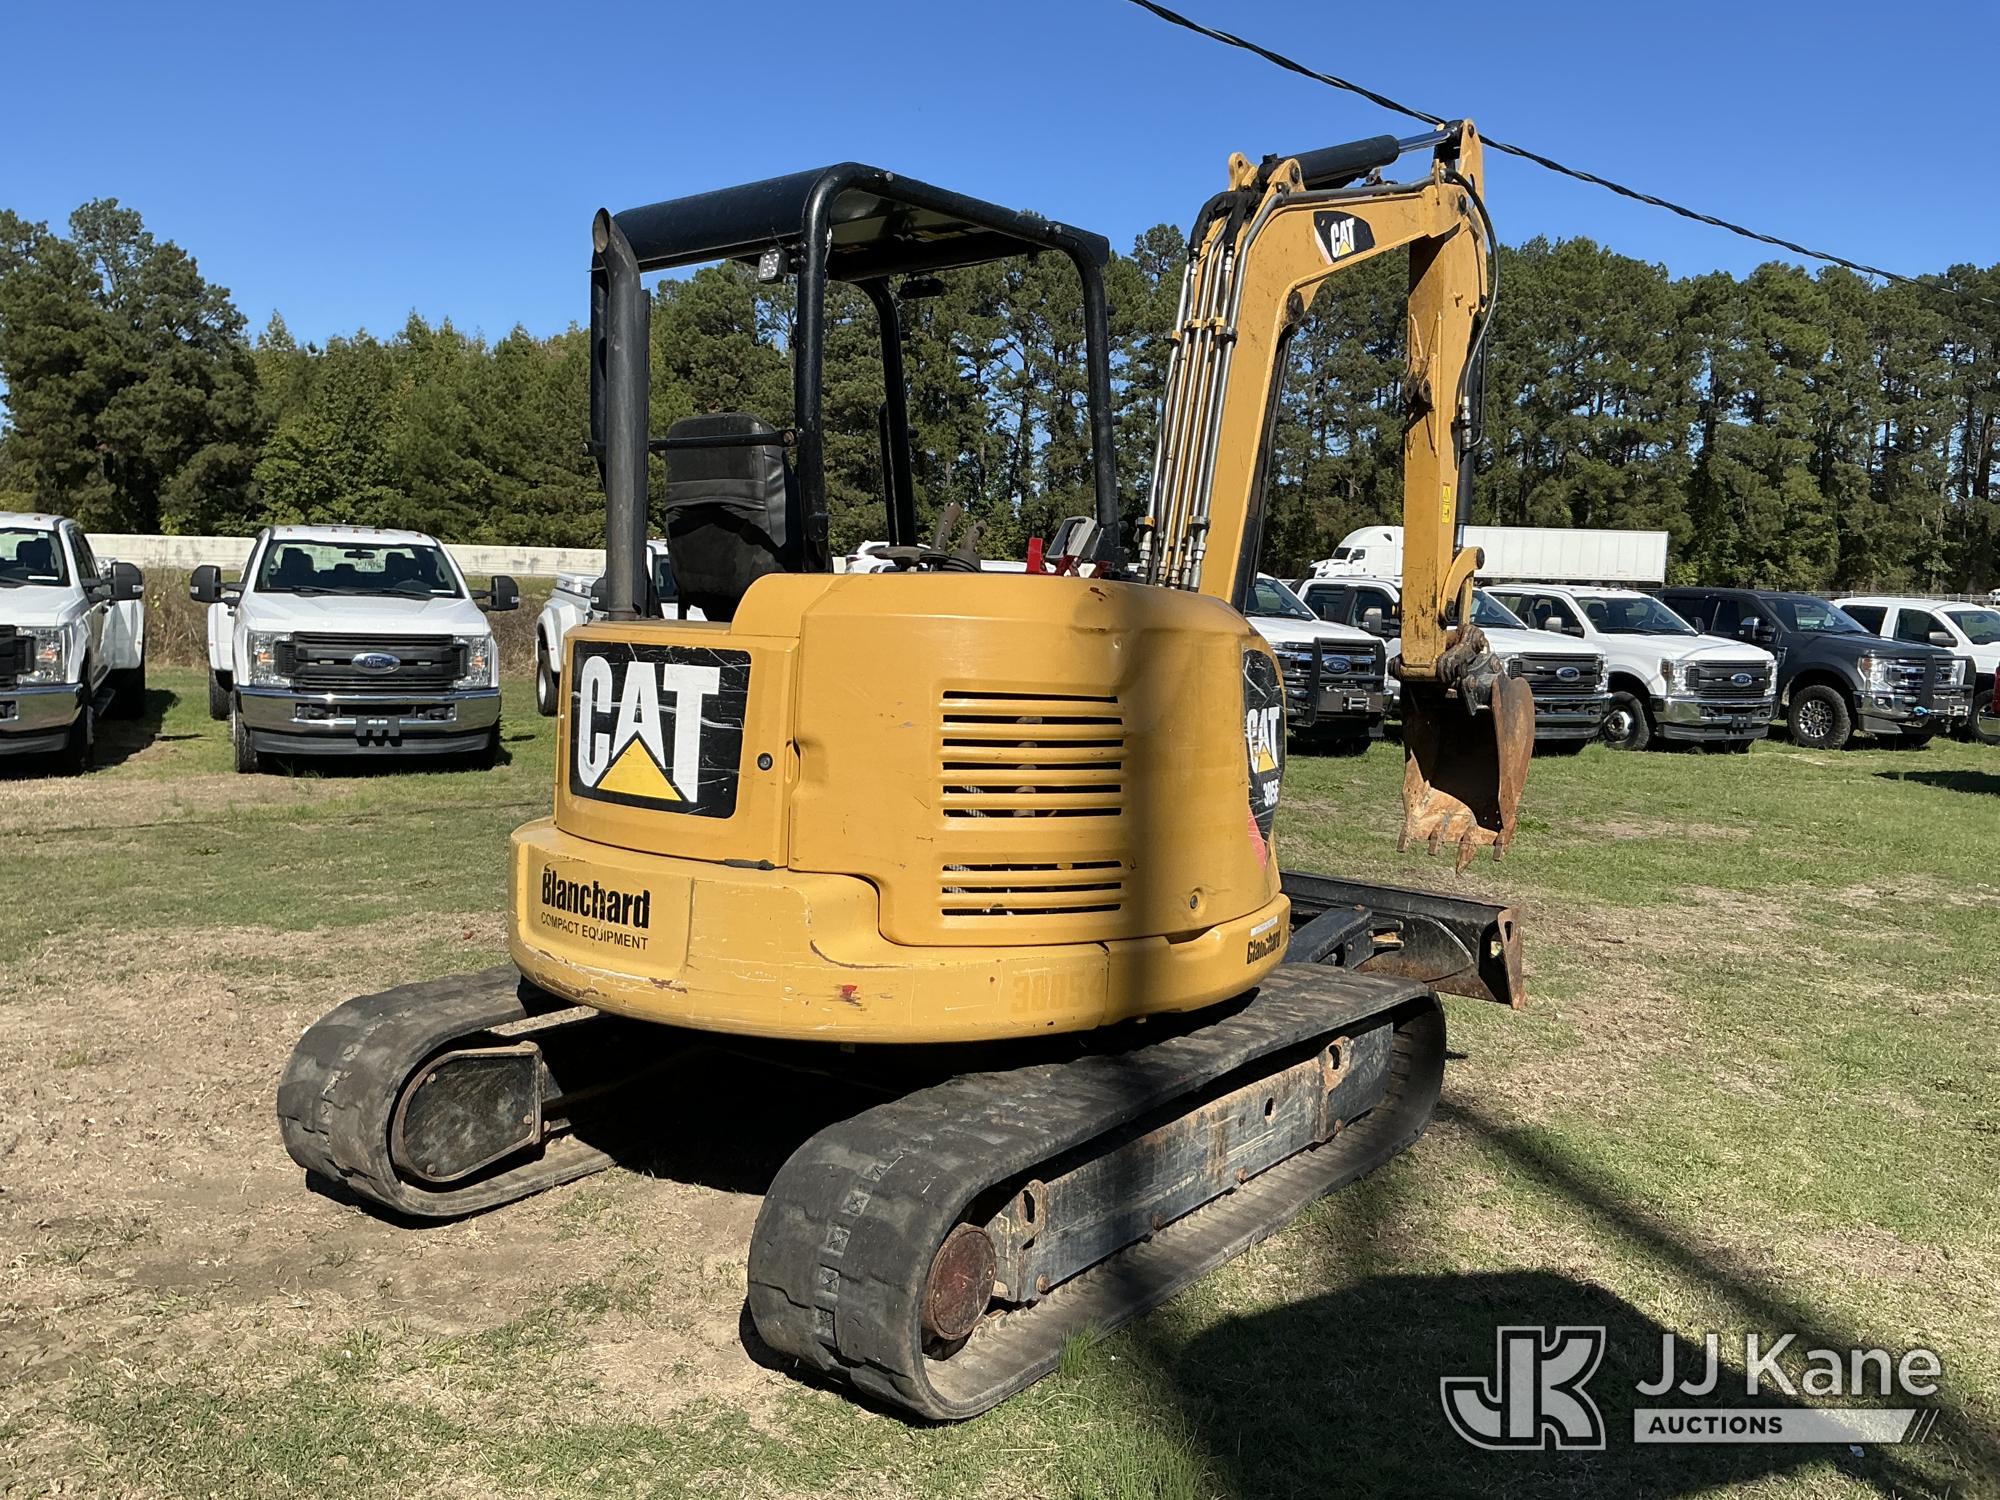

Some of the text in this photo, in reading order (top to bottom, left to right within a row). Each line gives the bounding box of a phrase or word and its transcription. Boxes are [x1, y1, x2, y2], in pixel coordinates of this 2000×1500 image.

[1330, 217, 1355, 258] CAT
[578, 655, 721, 803] CAT
[1247, 706, 1280, 774] CAT
[541, 868, 651, 929] Blanchard
[541, 911, 649, 951] COMPACT EQUIPMENT
